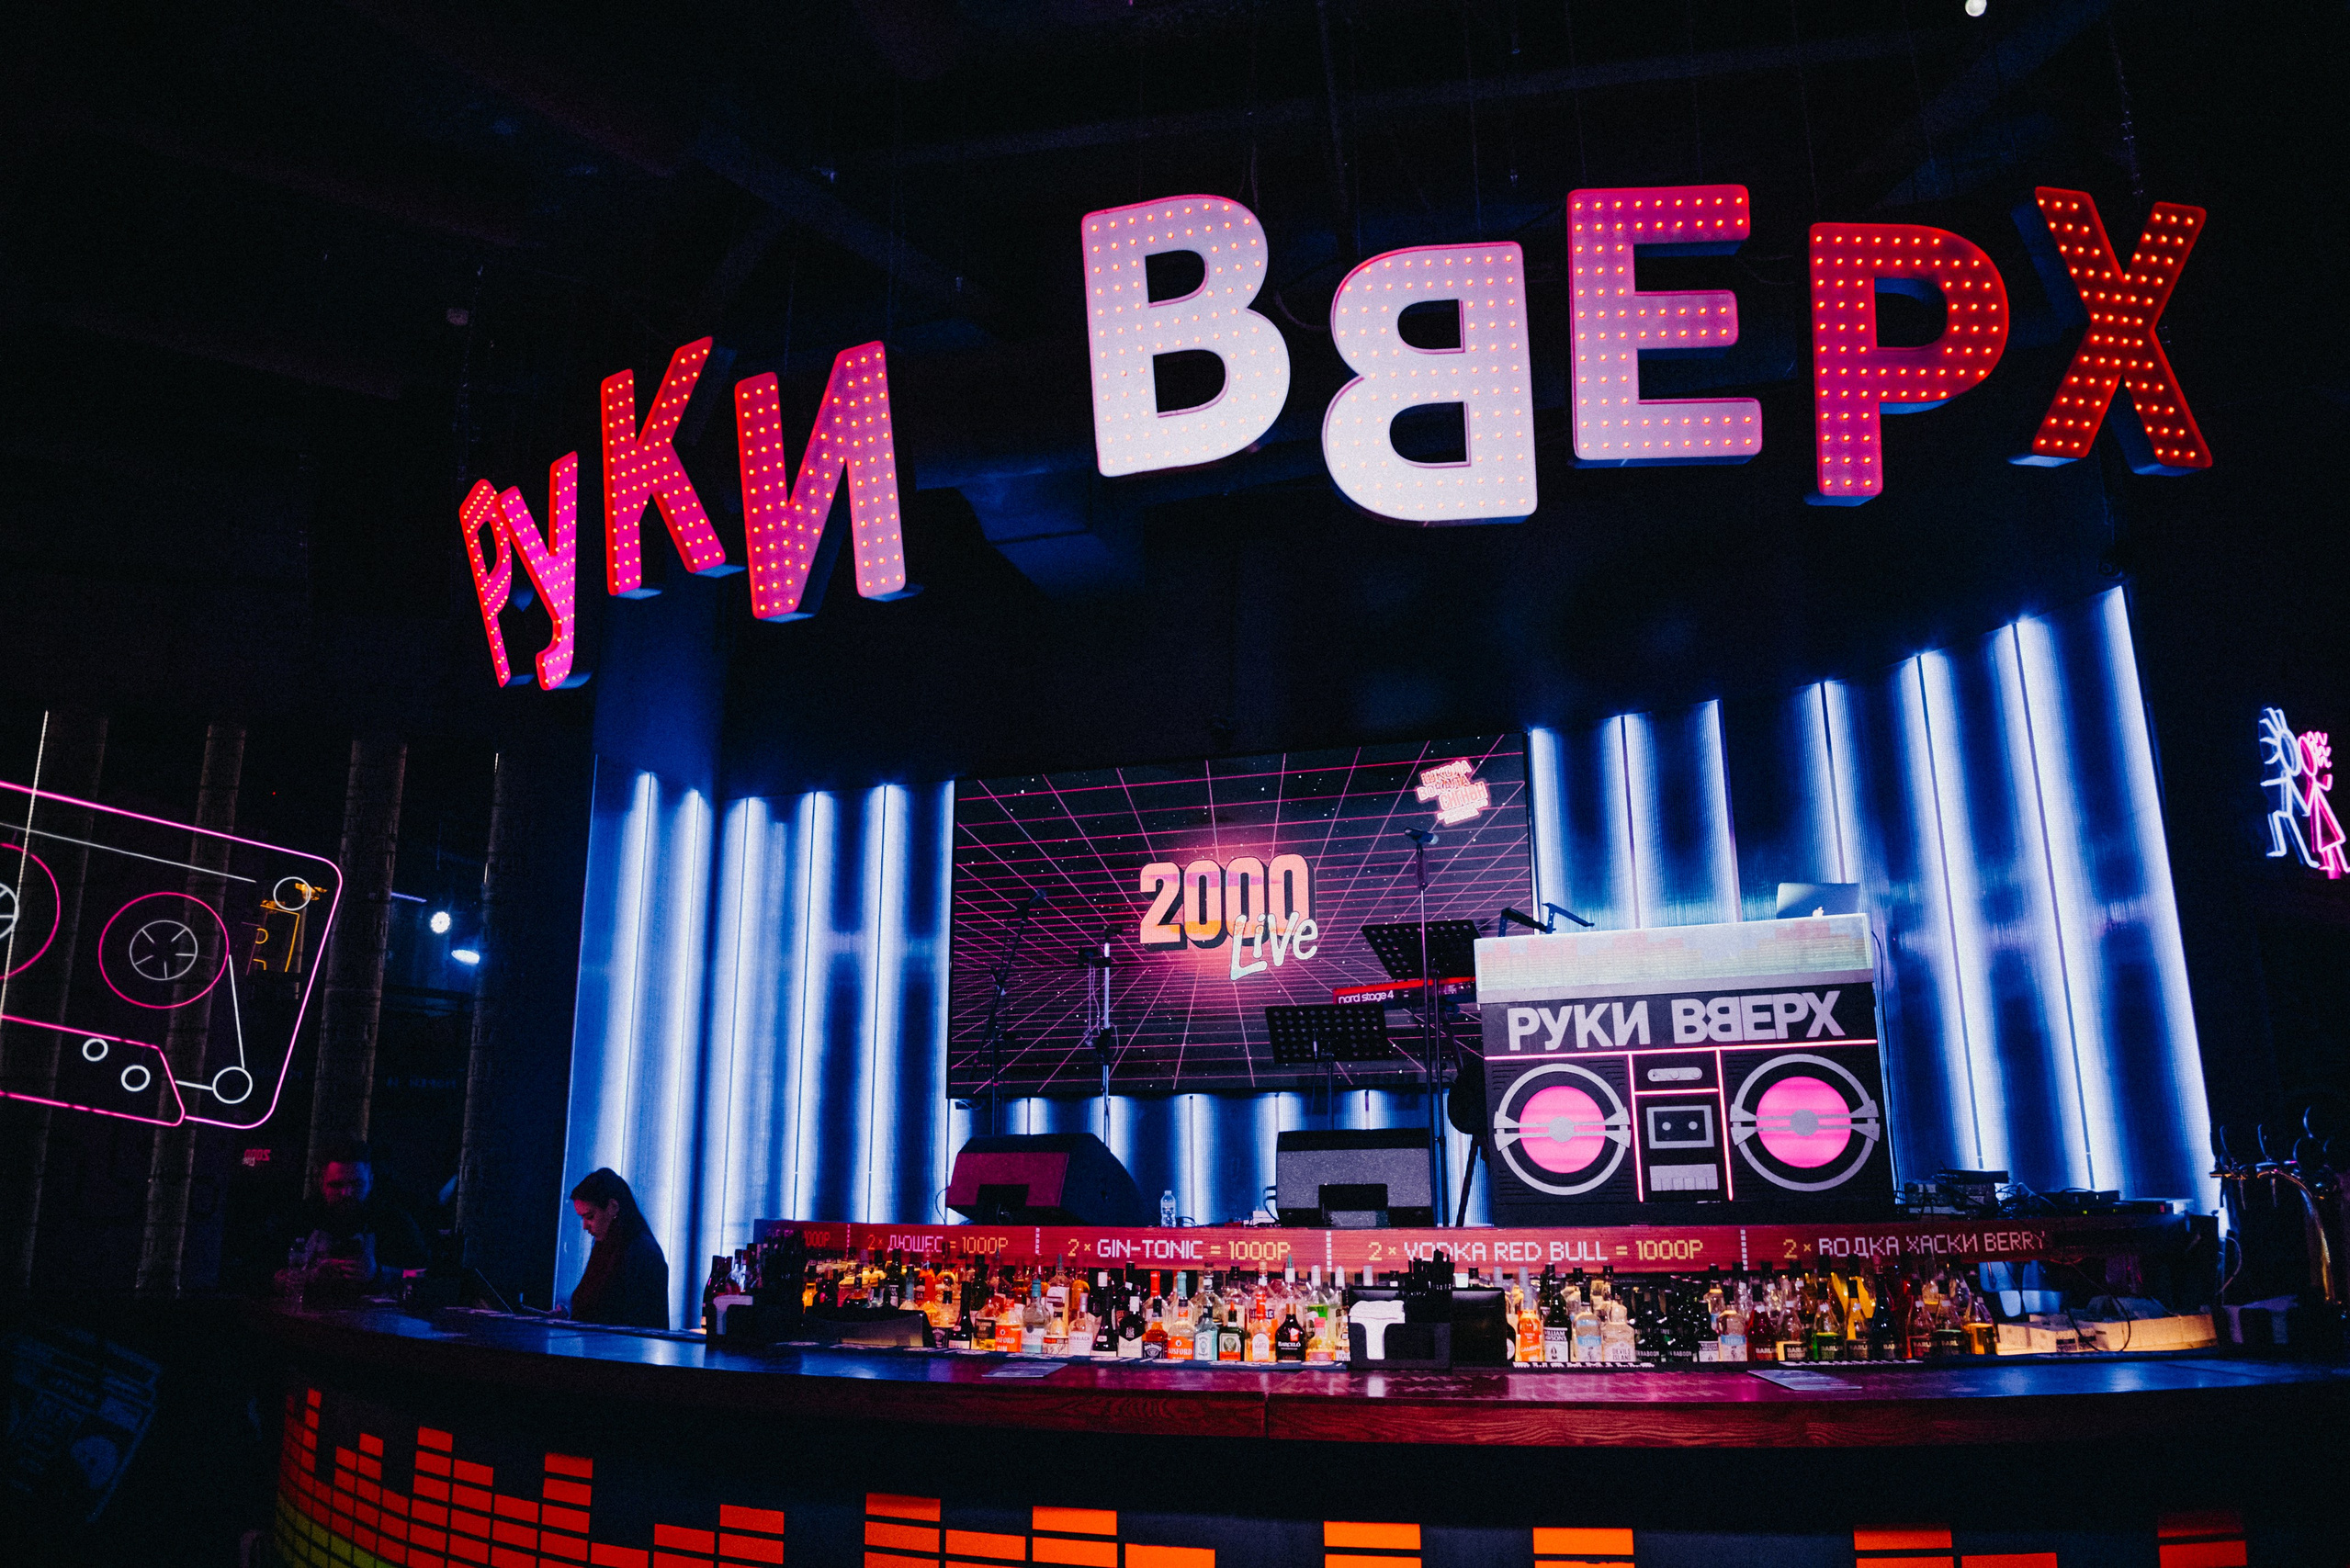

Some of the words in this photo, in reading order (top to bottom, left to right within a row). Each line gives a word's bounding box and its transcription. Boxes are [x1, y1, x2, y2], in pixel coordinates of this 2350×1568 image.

[459, 335, 906, 691] РУКИ
[1140, 853, 1313, 945] 2000
[1230, 911, 1318, 980] Live
[1339, 993, 1360, 1004] nord
[1361, 992, 1386, 1003] stage
[1387, 989, 1395, 999] 4
[1508, 1000, 1651, 1051] РУКИ
[868, 1235, 876, 1250] 2
[962, 1236, 1009, 1254] 1000Р
[1068, 1238, 1079, 1257] 2
[1097, 1239, 1203, 1259] GIN-TONIC
[1228, 1240, 1291, 1260] 1000Р
[1368, 1242, 1383, 1261] 2
[1494, 1241, 1542, 1261] RED
[1550, 1240, 1609, 1261] BULL
[1635, 1239, 1703, 1260] 1000Р
[1783, 1238, 1798, 1258] 2
[1905, 1234, 1978, 1254] ХАСКИ
[1983, 1231, 2046, 1252] BERRY
